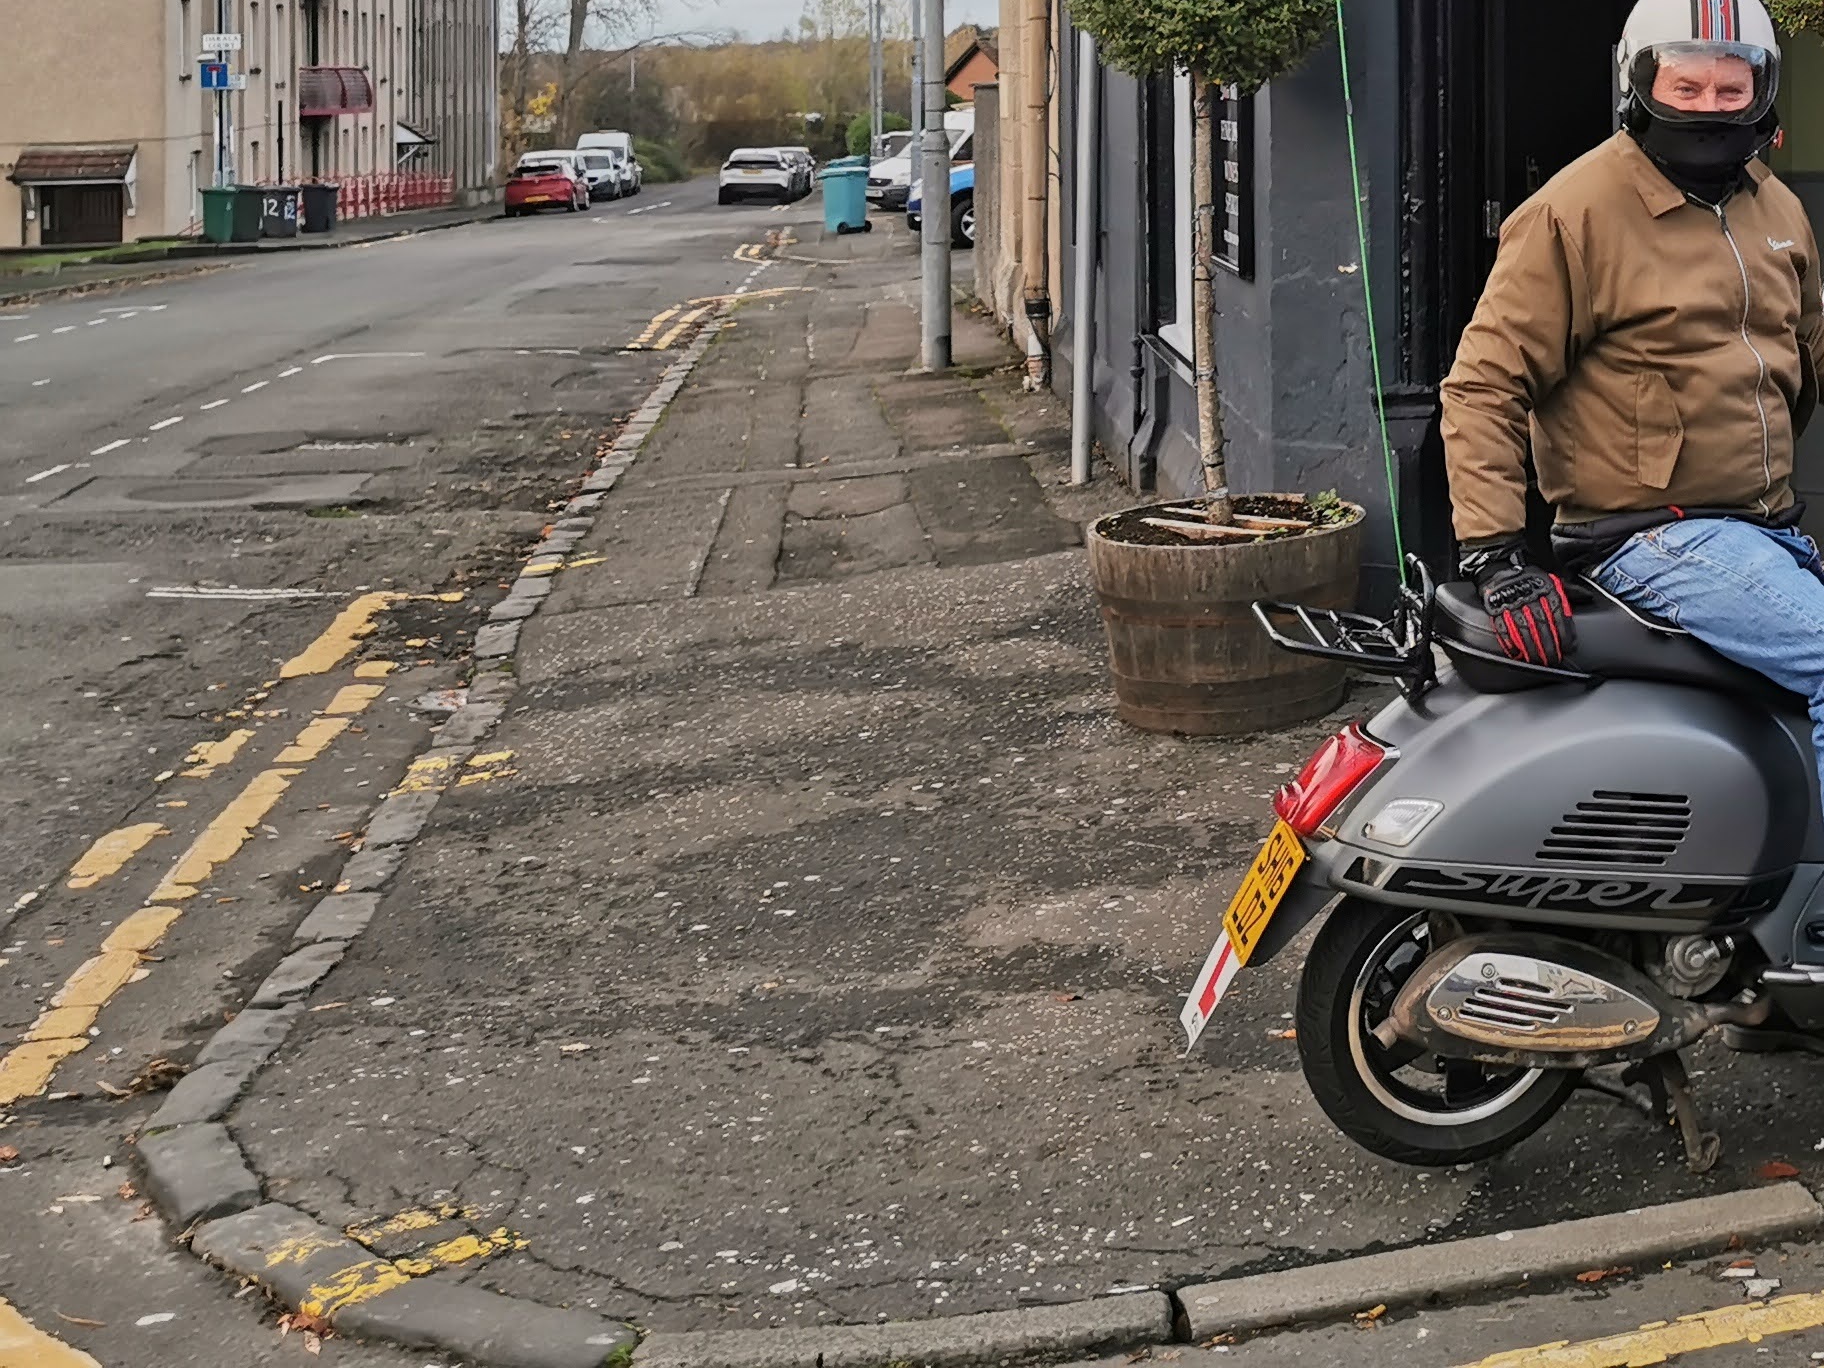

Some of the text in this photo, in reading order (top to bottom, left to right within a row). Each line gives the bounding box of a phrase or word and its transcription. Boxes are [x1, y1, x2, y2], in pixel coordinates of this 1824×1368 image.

[263, 198, 279, 217] 12
[1257, 831, 1294, 901] SH16
[1232, 877, 1267, 946] LDZ
